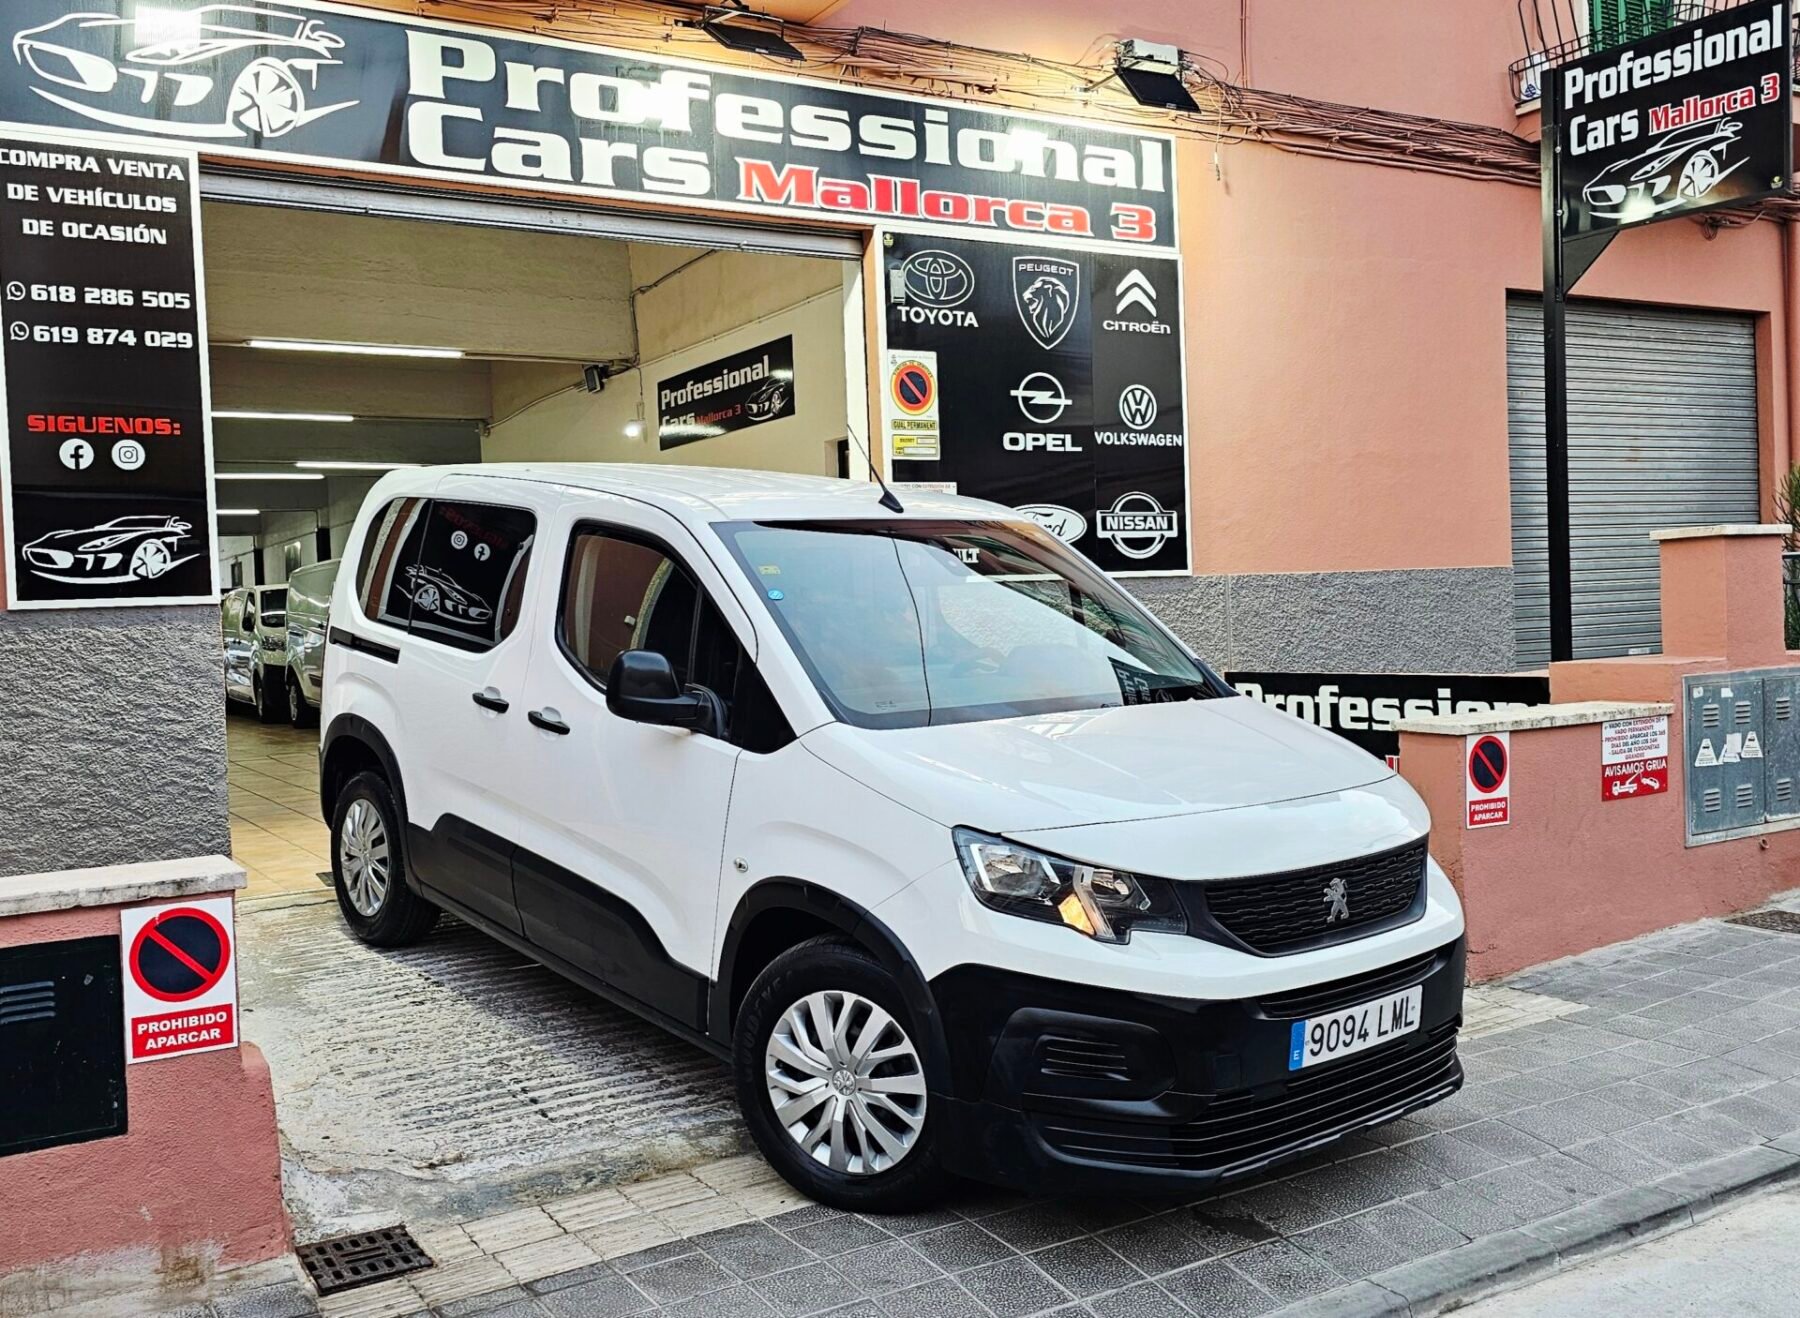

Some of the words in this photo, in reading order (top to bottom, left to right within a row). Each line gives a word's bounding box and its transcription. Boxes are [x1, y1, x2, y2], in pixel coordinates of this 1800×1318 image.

[1565, 3, 1783, 110] Professional
[405, 29, 1166, 193] Professional
[1570, 109, 1639, 156] Cars
[1649, 85, 1755, 136] Mallorca
[1761, 72, 1780, 104] 3
[0, 149, 100, 173] COMPRA
[107, 158, 185, 181] VENTA
[408, 101, 711, 196] Cars
[734, 156, 1094, 238] Mallorca
[1110, 202, 1157, 243] 3
[7, 183, 39, 201] DE
[46, 187, 177, 213] VEHÍCULOS
[22, 218, 55, 236] DE
[62, 221, 167, 245] OCASIÓN
[1018, 262, 1075, 276] PEUGEOT
[30, 284, 76, 303] 618
[84, 287, 134, 306] 286
[142, 291, 191, 309] 505
[896, 305, 979, 328] TOYOTA
[33, 325, 78, 343] 619
[87, 328, 137, 346] 874
[144, 330, 193, 348] 029
[661, 354, 770, 410] Professional
[27, 414, 181, 436] SIGUENOS:
[695, 407, 732, 425] Mallorca
[735, 403, 742, 415] 3
[1003, 432, 1083, 452] OPEL
[1094, 431, 1182, 447] VOLKSWAGEN
[1024, 511, 1067, 537] Frd
[1105, 515, 1168, 530] NISSAN
[1604, 762, 1644, 777] AVISAMOS
[1646, 758, 1667, 771] GRUA
[1471, 801, 1506, 812] PROHIBIDO
[1473, 811, 1503, 821] APARCAR
[137, 1011, 228, 1035] PROHIBIDO
[1309, 1009, 1370, 1057] 9094
[1377, 996, 1415, 1037] LML
[145, 1028, 221, 1050] APARCAR
